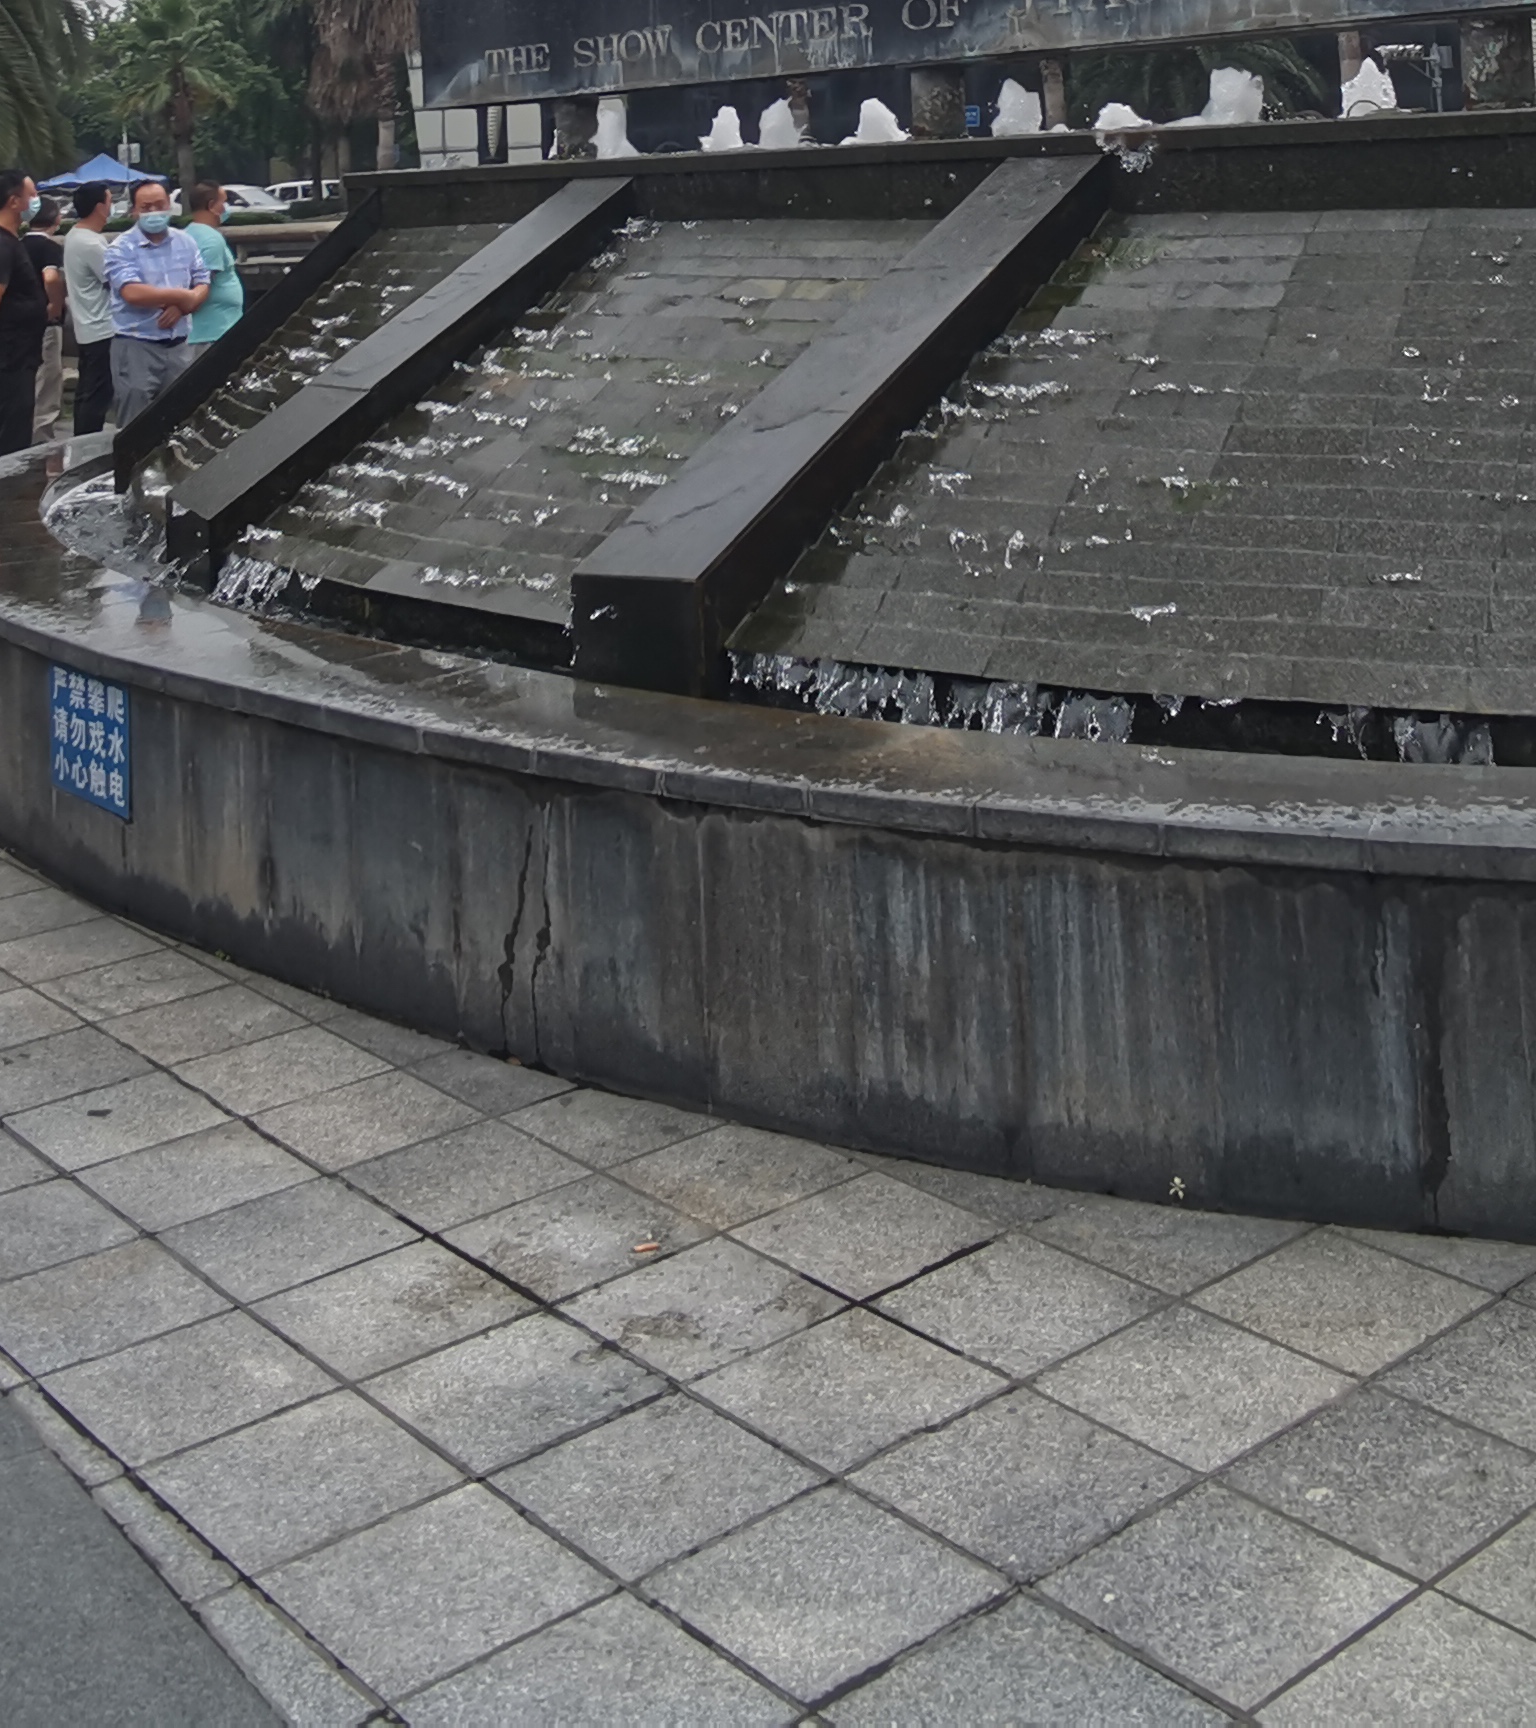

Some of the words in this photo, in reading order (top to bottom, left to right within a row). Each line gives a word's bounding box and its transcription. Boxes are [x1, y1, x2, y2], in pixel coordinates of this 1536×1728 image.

[484, 42, 551, 77] THE
[573, 24, 672, 68] SHOW
[695, 2, 872, 55] CENTER
[52, 665, 125, 725] 严禁攀爬
[52, 705, 126, 765] 请勿戏水
[53, 745, 126, 808] 小心触电
